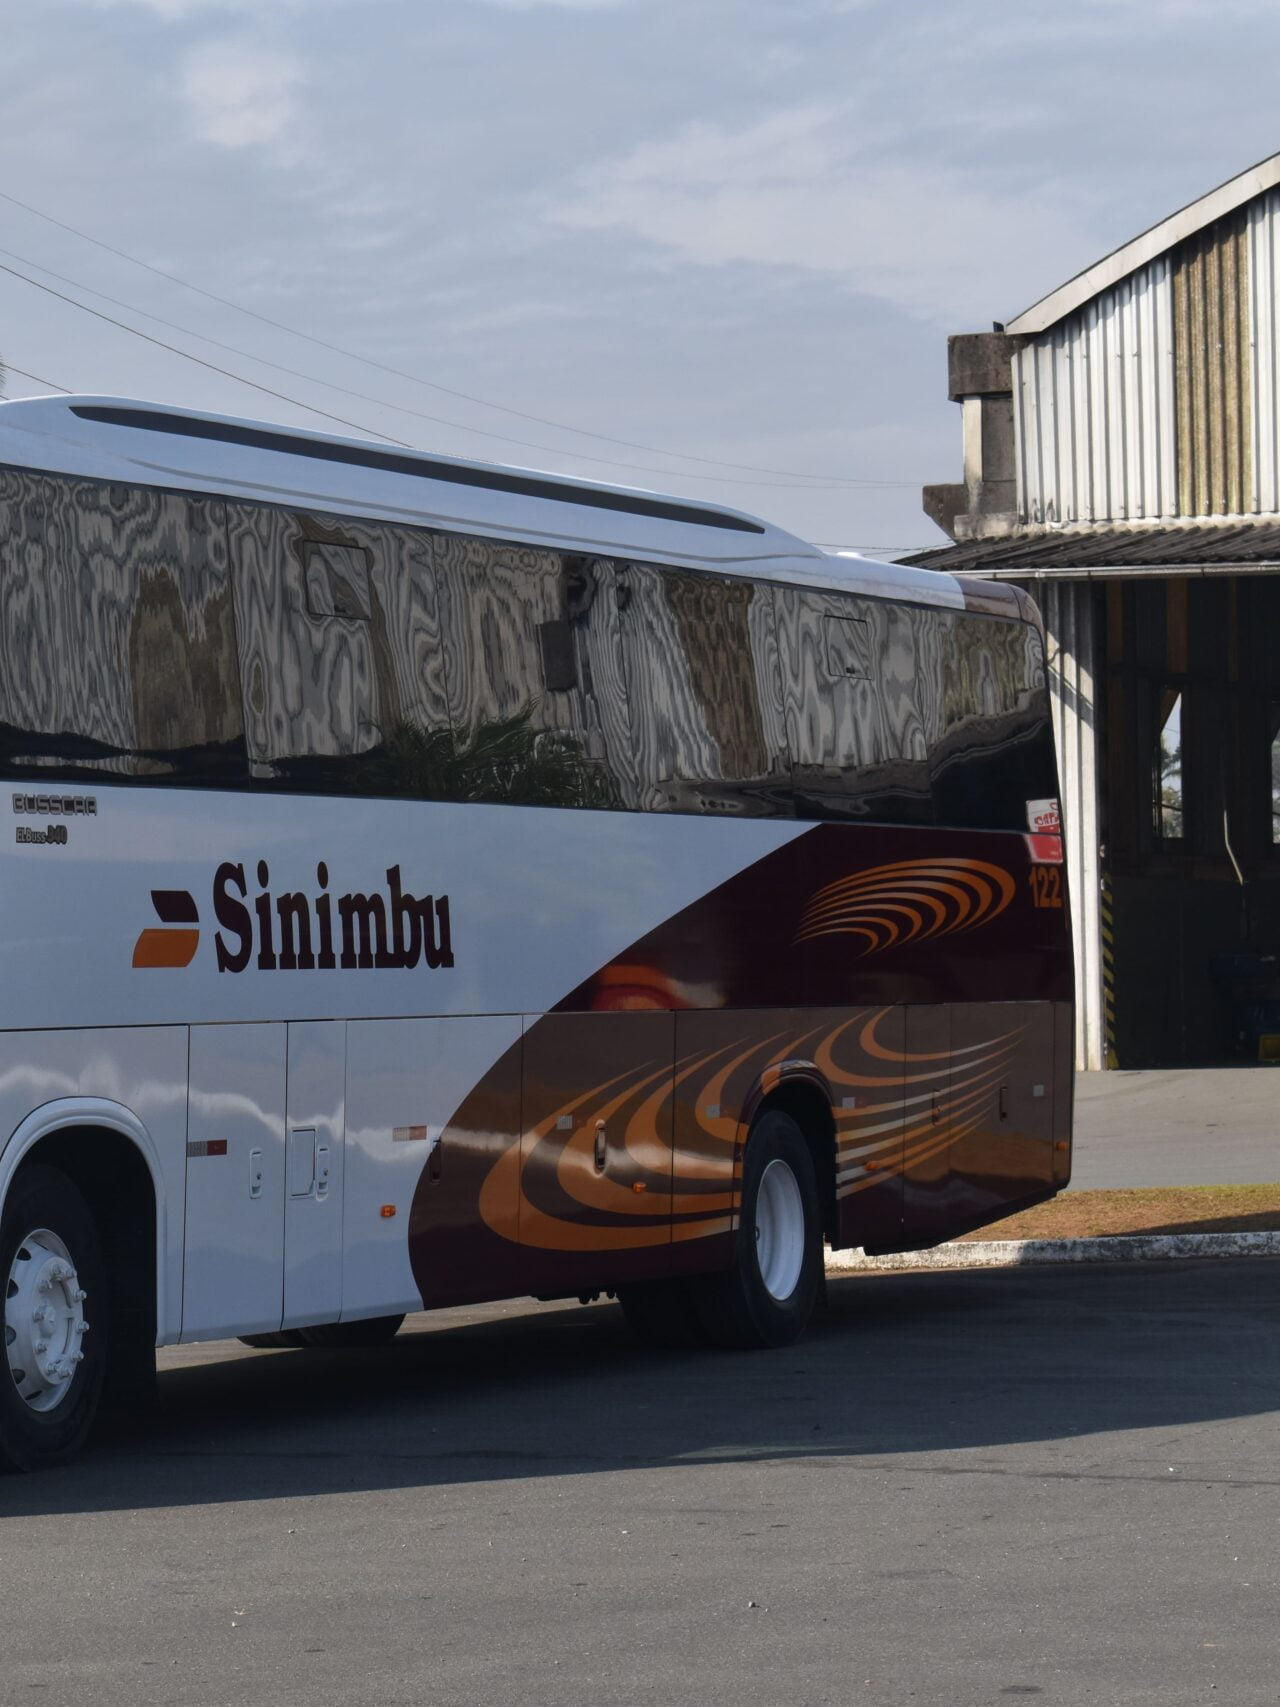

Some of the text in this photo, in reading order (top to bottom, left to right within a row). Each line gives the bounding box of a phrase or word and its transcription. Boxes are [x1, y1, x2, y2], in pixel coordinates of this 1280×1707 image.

[12, 793, 97, 816] BUSSCAR
[1029, 866, 1061, 908] 122
[212, 859, 455, 972] Sinimbu
